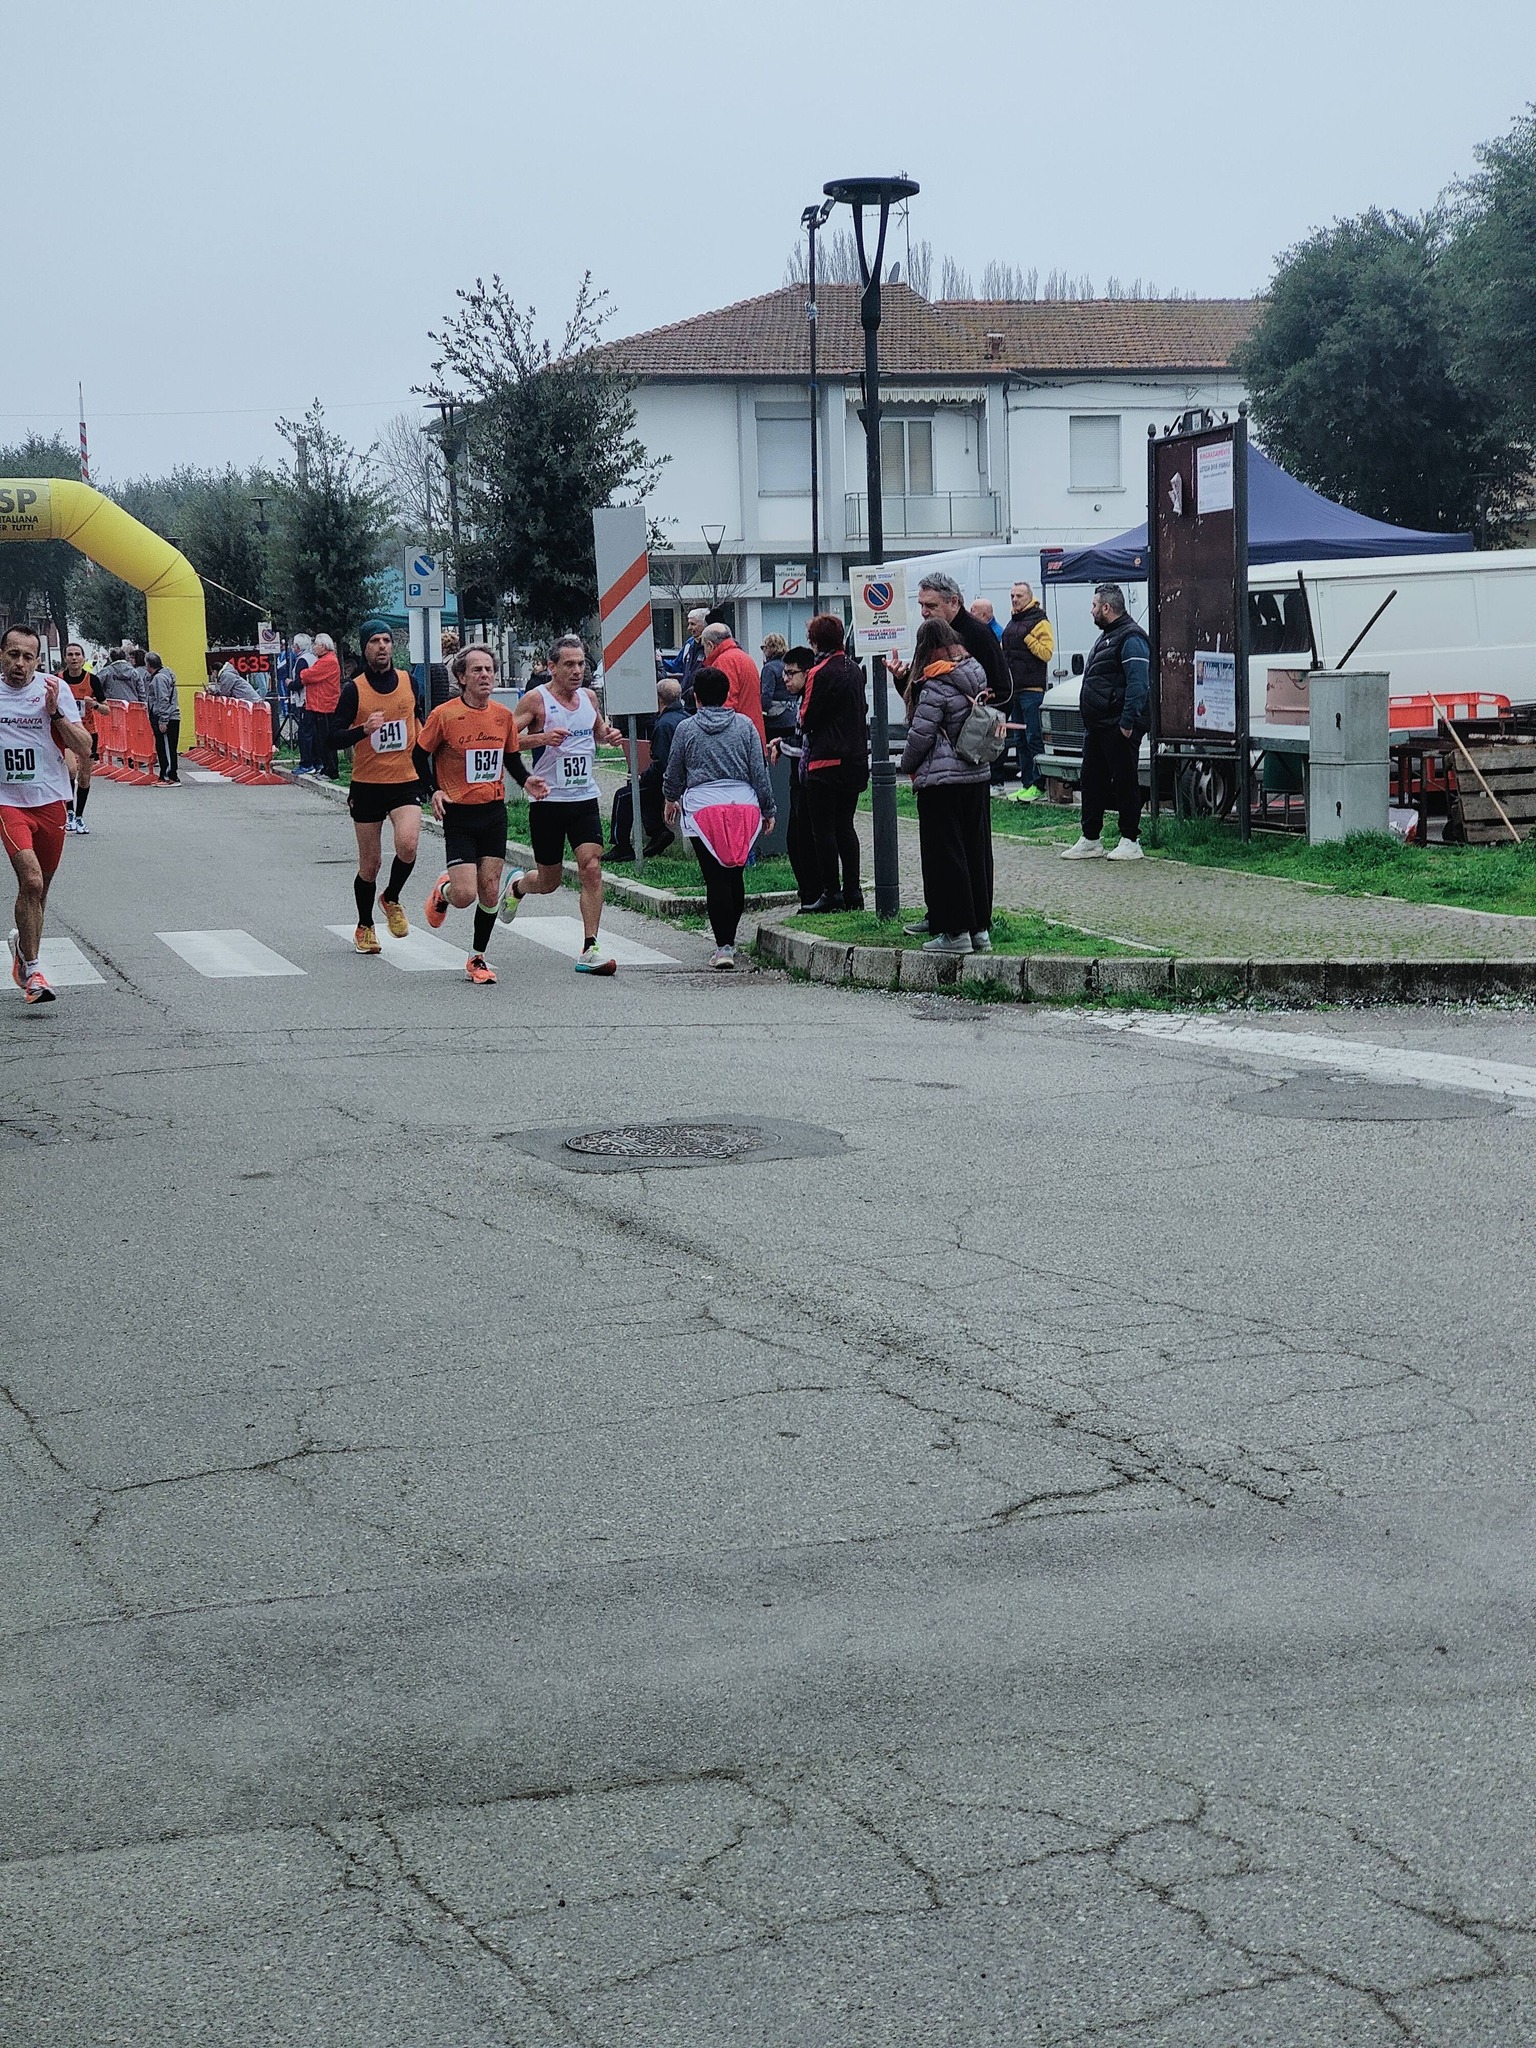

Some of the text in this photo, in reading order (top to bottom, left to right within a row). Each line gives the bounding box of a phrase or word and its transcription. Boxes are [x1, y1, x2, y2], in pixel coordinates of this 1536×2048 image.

[411, 585, 419, 595] P
[380, 721, 401, 742] 541
[4, 748, 35, 771] 650
[474, 750, 498, 771] 634
[564, 756, 587, 777] 532
